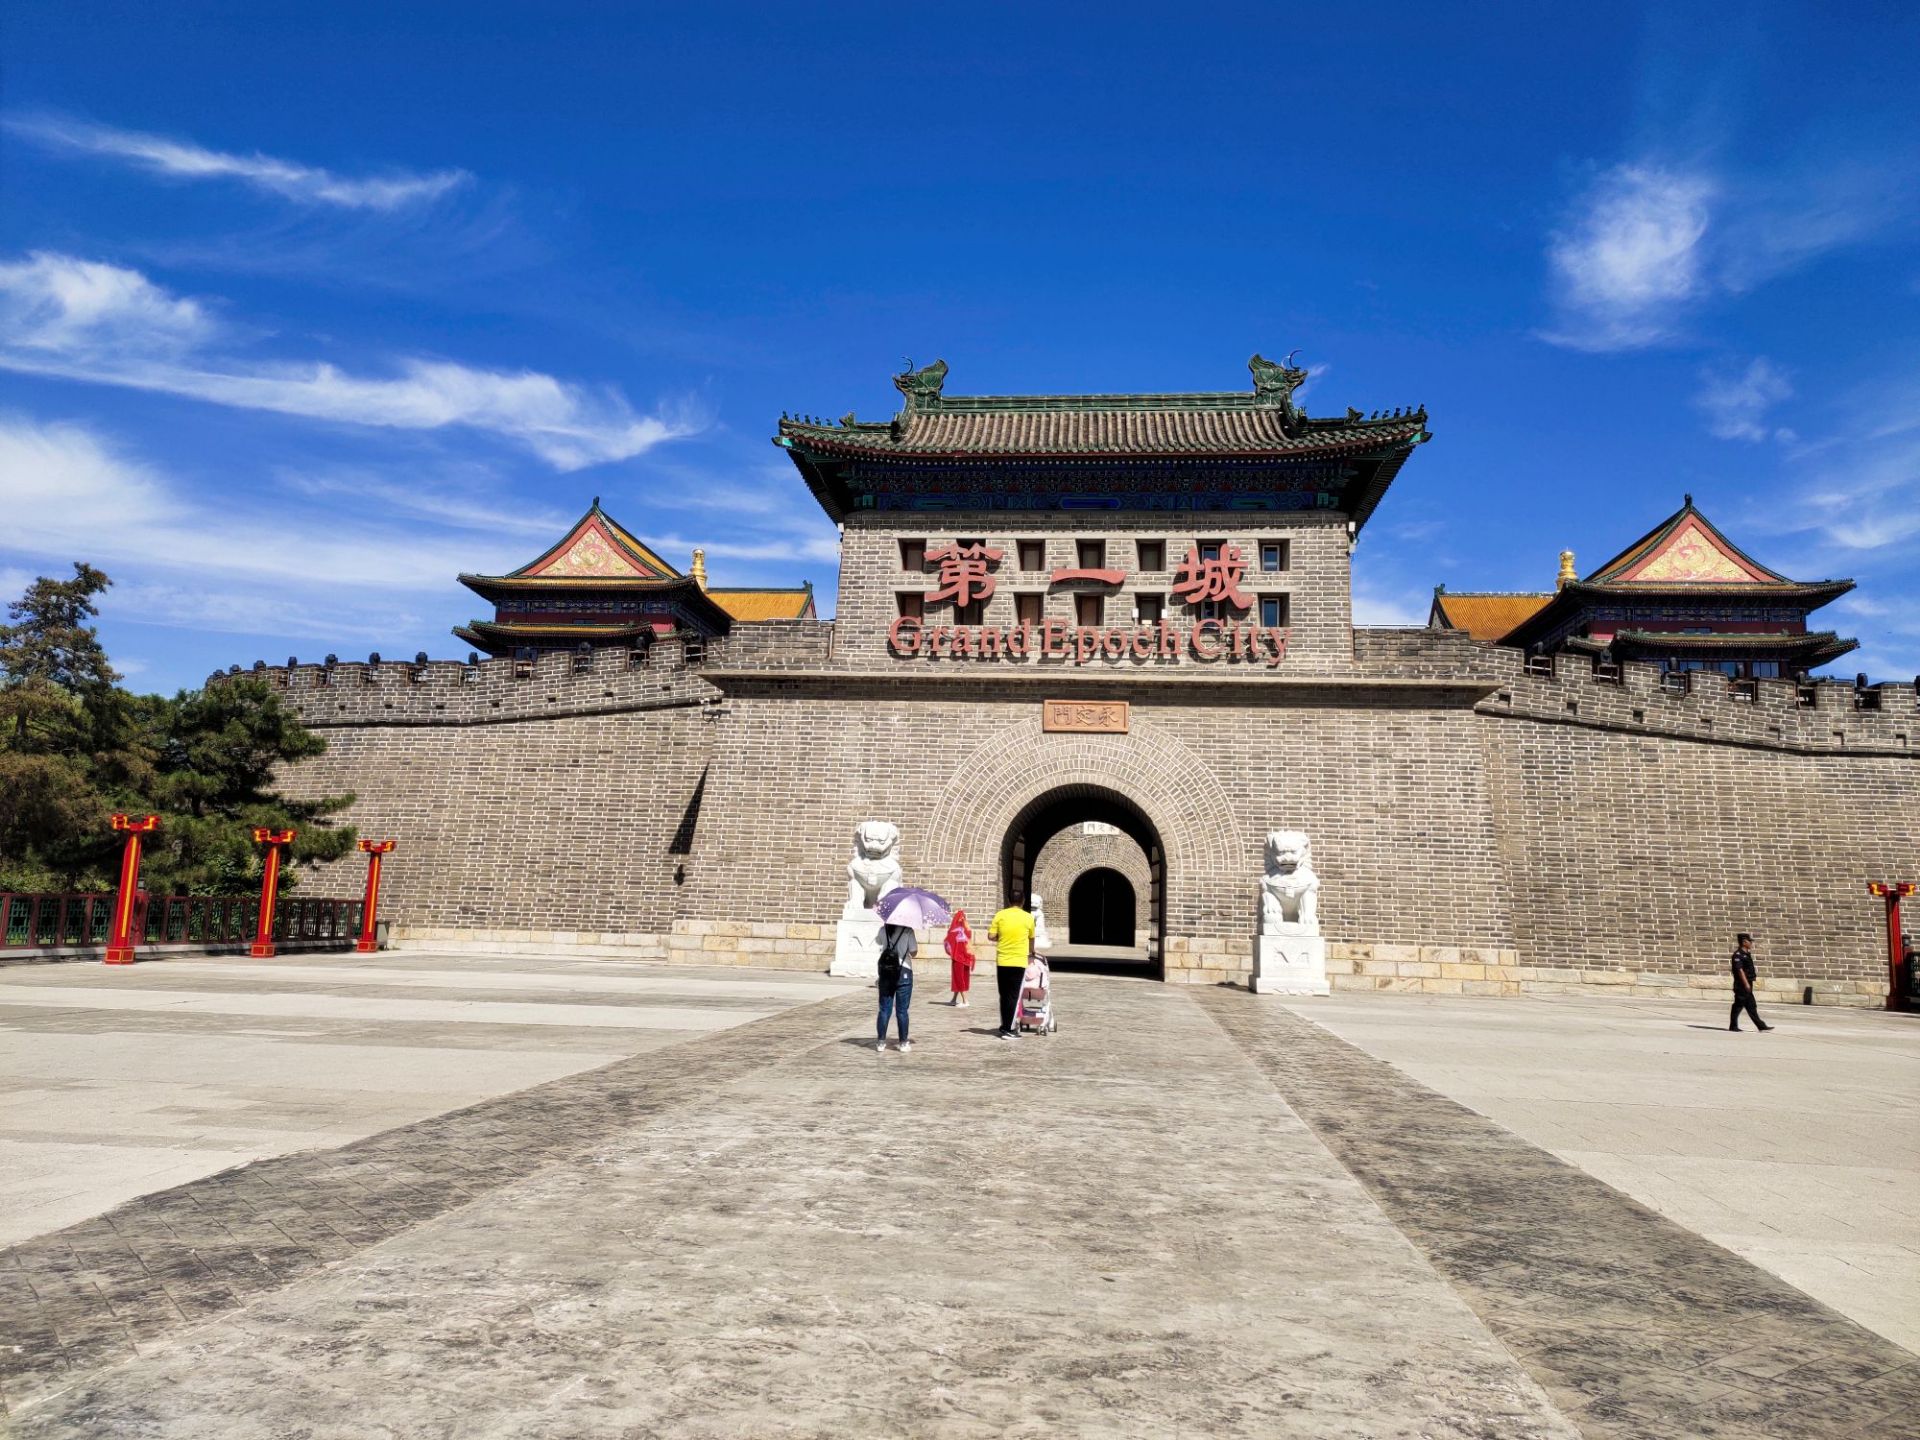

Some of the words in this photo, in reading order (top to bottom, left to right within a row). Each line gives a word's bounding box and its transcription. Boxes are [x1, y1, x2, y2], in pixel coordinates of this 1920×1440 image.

[924, 542, 1255, 609] 第一城
[889, 616, 1031, 653] Grand
[1040, 617, 1182, 664] Epoch
[1191, 618, 1289, 664] City
